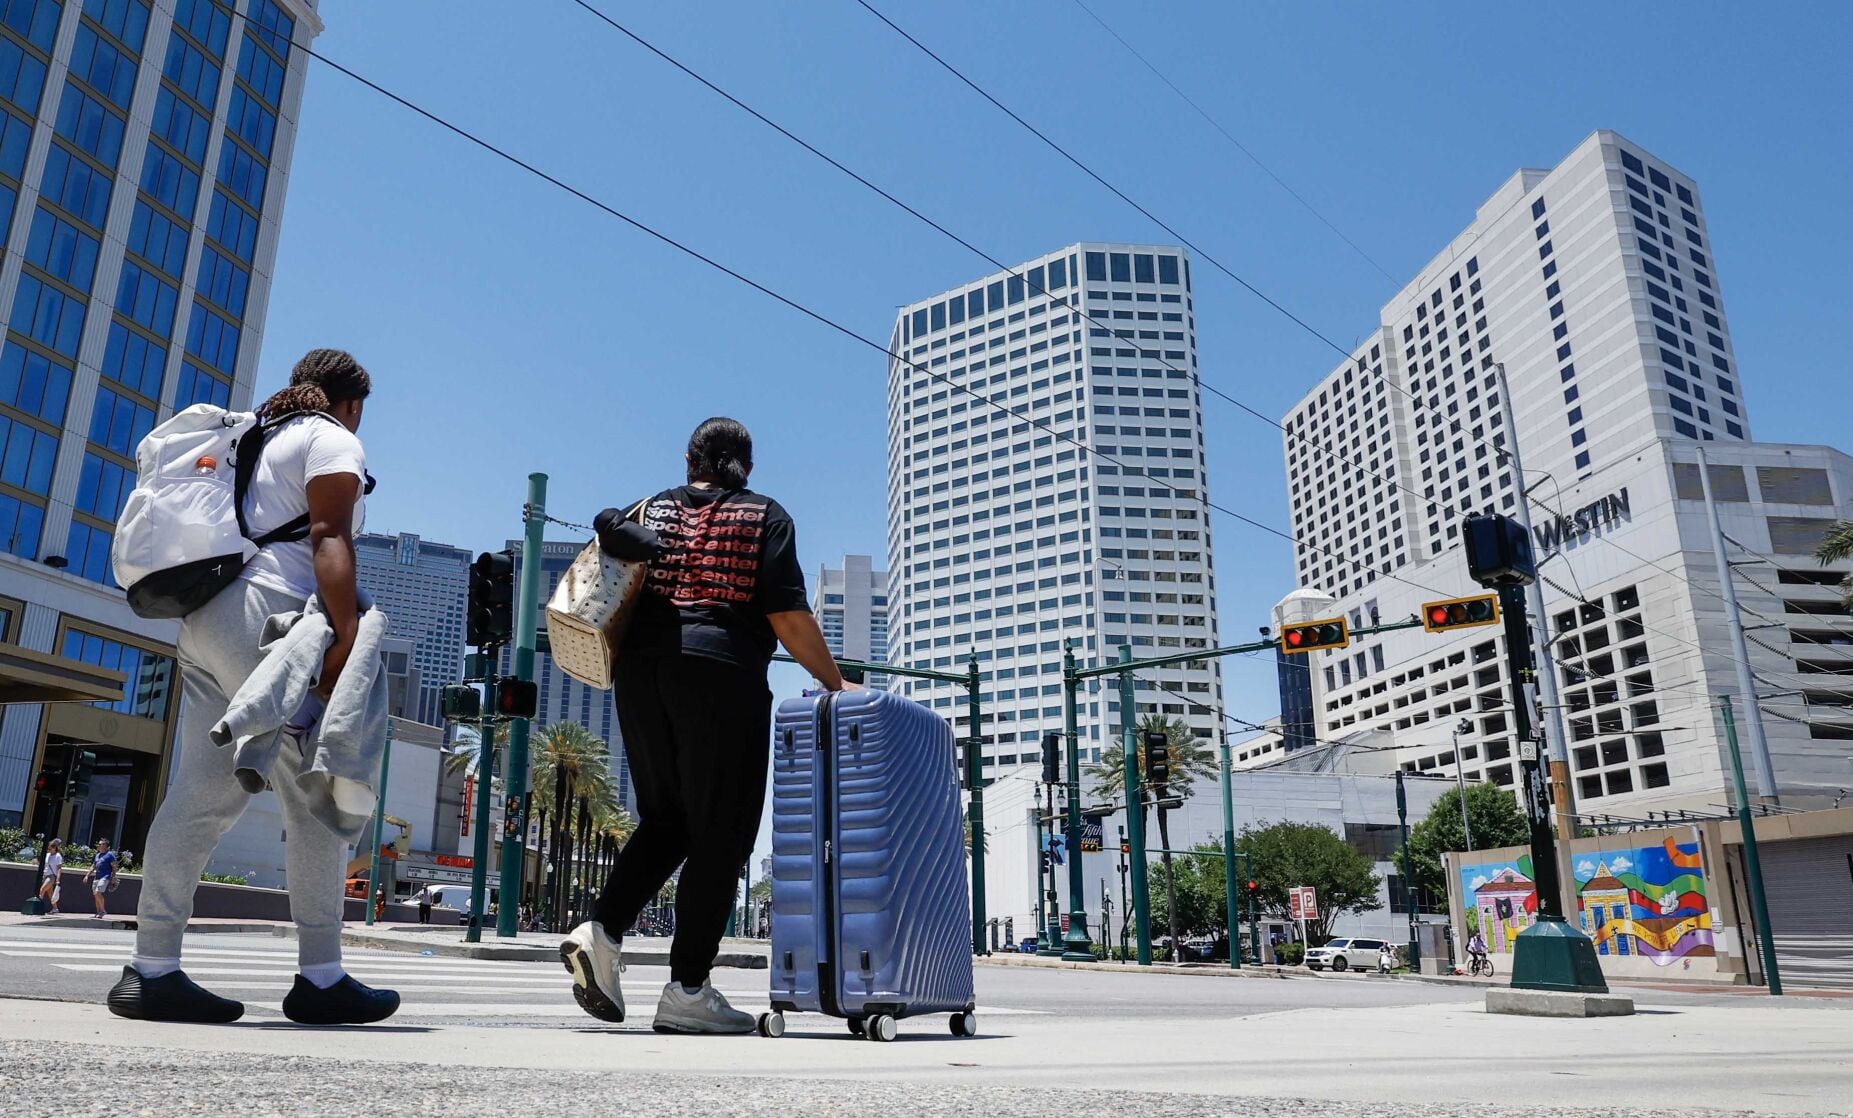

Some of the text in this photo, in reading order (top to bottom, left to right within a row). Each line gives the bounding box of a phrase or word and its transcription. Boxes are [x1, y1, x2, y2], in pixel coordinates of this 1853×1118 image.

[646, 506, 765, 526] SpotsCenter
[1533, 487, 1630, 552] WESTIN
[513, 542, 574, 554] Saton
[650, 568, 756, 587] ortsCenter
[651, 583, 754, 602] ortsCenter
[1305, 894, 1313, 908] P
